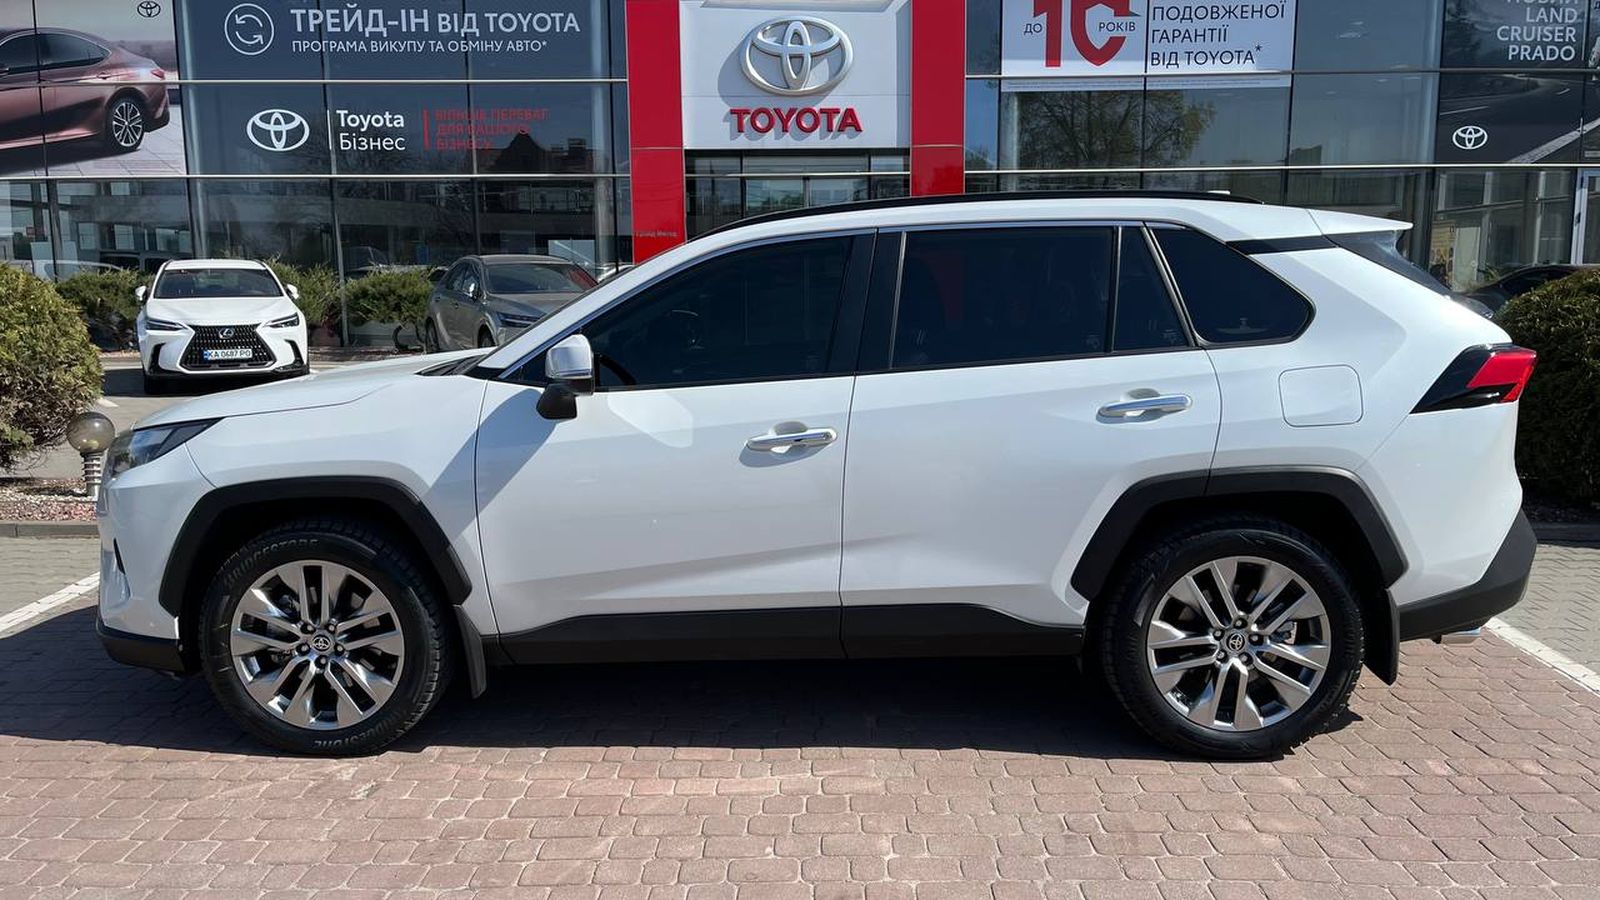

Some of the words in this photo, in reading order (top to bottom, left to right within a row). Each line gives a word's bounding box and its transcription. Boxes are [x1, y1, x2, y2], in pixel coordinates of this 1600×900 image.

[290, 3, 429, 37] ТРЕЙД-ІН
[438, 13, 480, 37] ВІД
[485, 13, 580, 33] TOYOTA
[1152, 1, 1285, 22] ПОДОВЖЕНОЇ
[1526, 7, 1578, 23] LAND
[1024, 23, 1043, 35] ДО
[1099, 22, 1136, 32] РОКІВ
[1151, 25, 1229, 43] ГАРАНТІЇ
[1497, 26, 1576, 43] CRUISER
[292, 40, 367, 52] ПРОГРАМА
[370, 41, 426, 52] ВИКУПУ
[429, 41, 445, 51] ТА
[448, 41, 503, 51] ОБМІНУ
[1508, 45, 1575, 61] PRADO
[1150, 51, 1179, 68] ВІД
[336, 110, 405, 131] Toyota
[730, 107, 863, 133] TOYOTA
[340, 133, 406, 150] Бізнес
